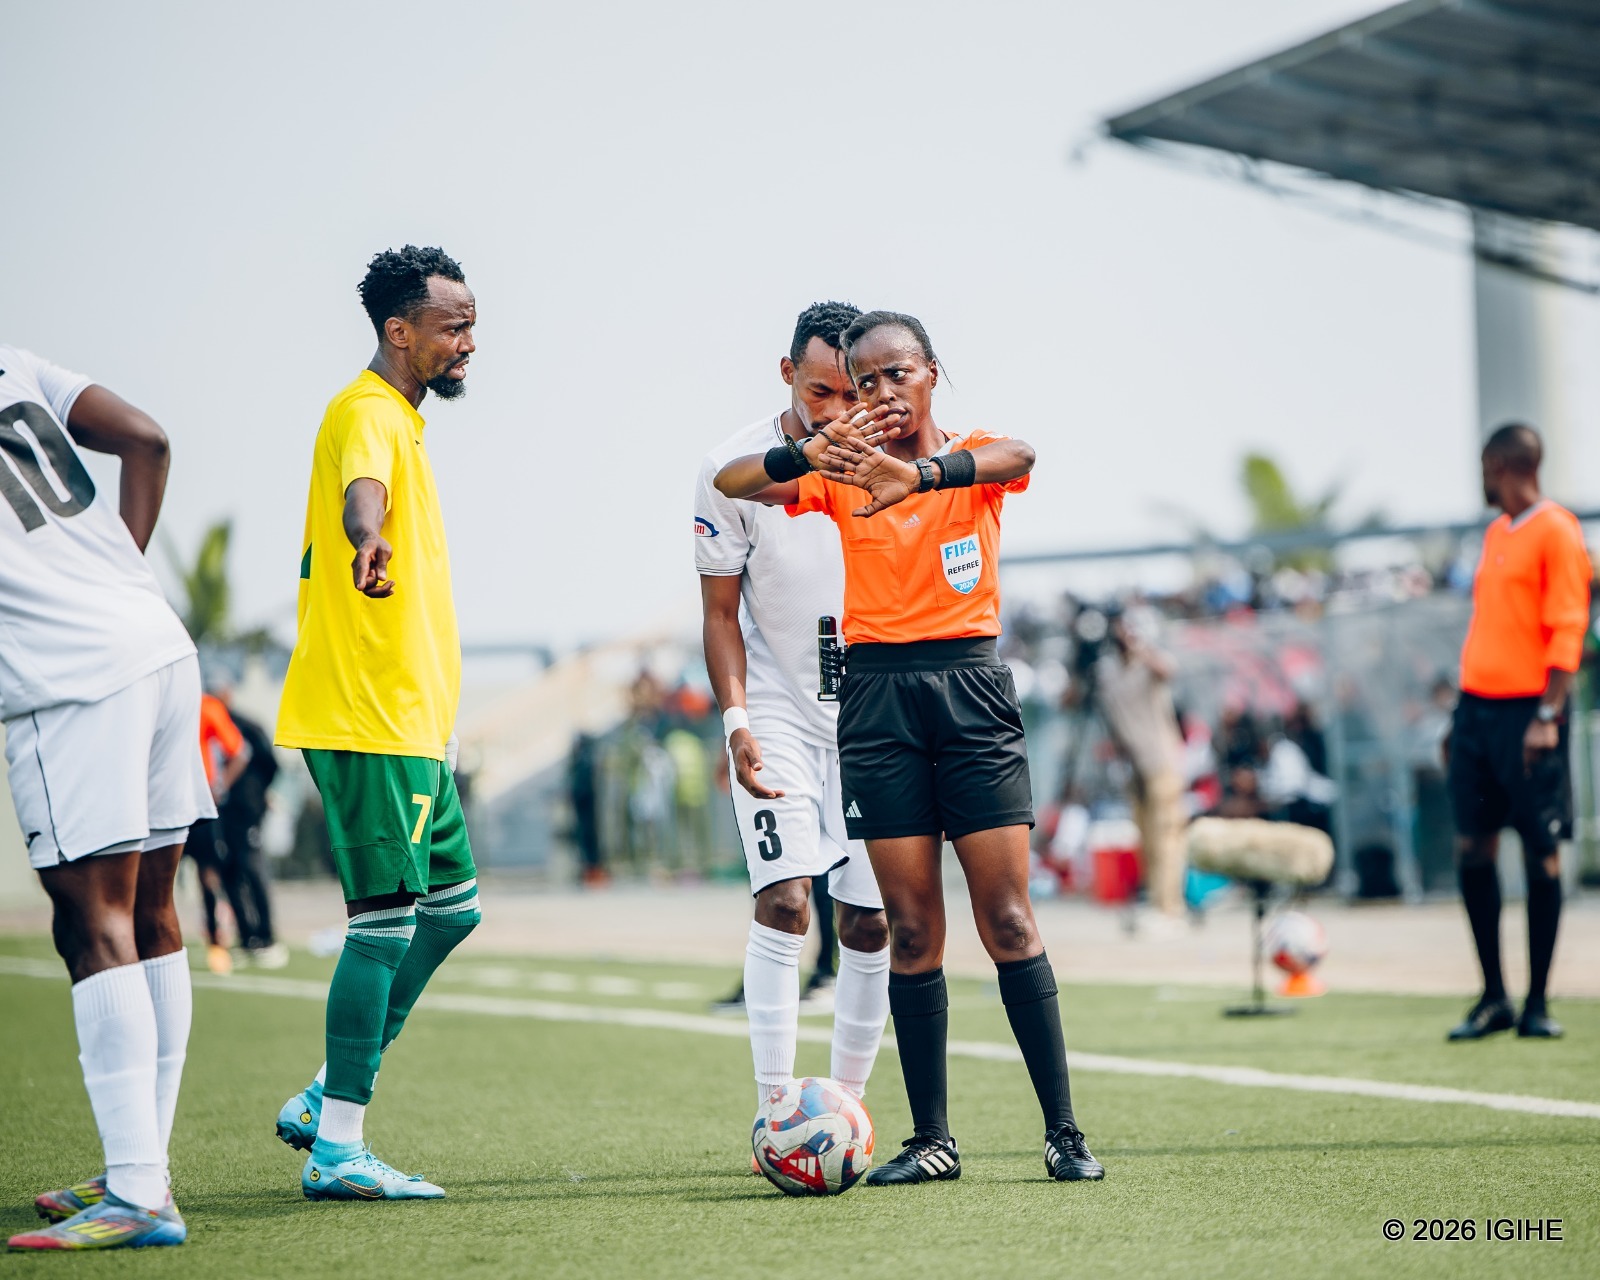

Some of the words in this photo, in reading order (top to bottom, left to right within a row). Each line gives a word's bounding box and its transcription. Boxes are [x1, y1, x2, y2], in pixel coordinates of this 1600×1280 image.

[944, 539, 977, 560] FIFA
[947, 559, 980, 576] REFEREE
[959, 579, 975, 591] 2026
[411, 793, 432, 844] 7
[753, 809, 783, 861] 3
